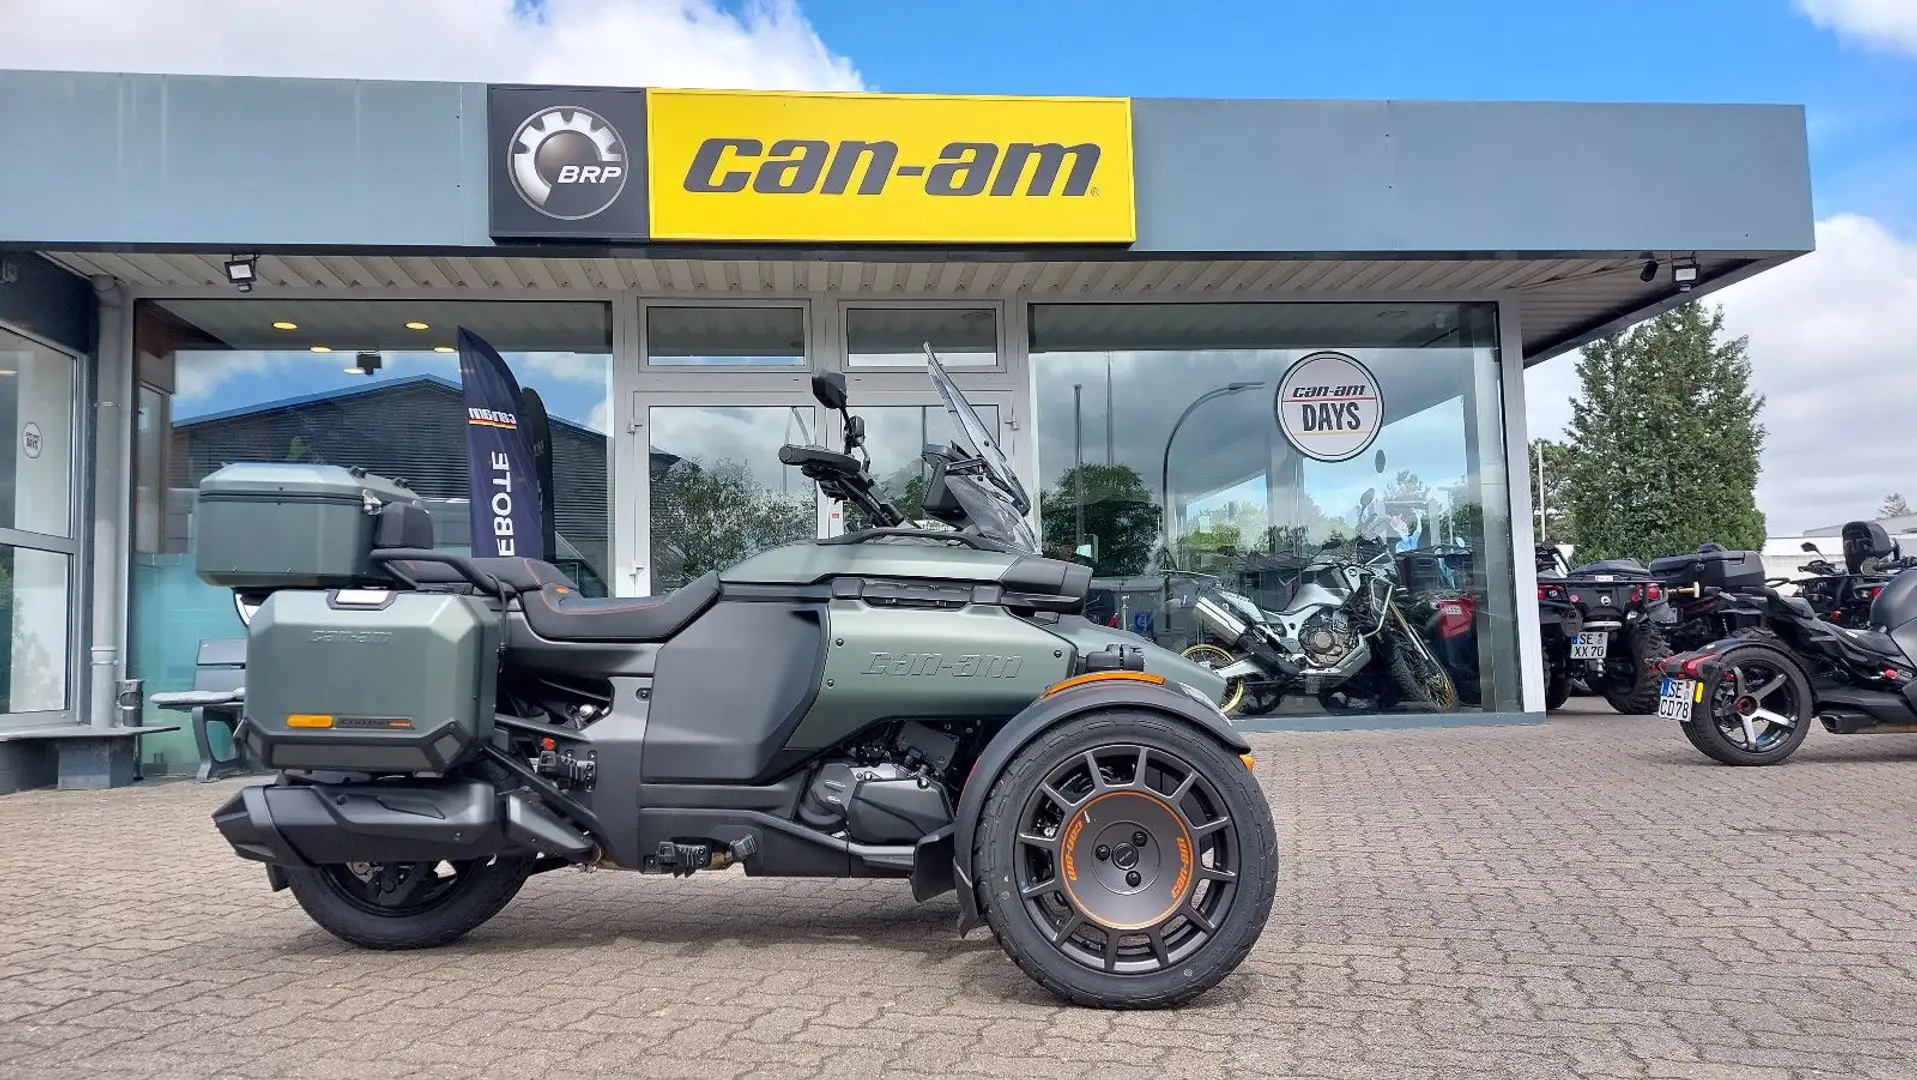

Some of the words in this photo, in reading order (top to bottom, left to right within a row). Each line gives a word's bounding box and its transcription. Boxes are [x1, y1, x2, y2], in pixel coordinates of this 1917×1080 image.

[557, 165, 622, 184] BRP
[683, 137, 1102, 198] can-am
[1292, 384, 1366, 398] can-am
[1301, 401, 1361, 432] DAYS
[1579, 633, 1594, 645] SE
[860, 651, 1025, 679] can-am
[1669, 681, 1684, 699] SE
